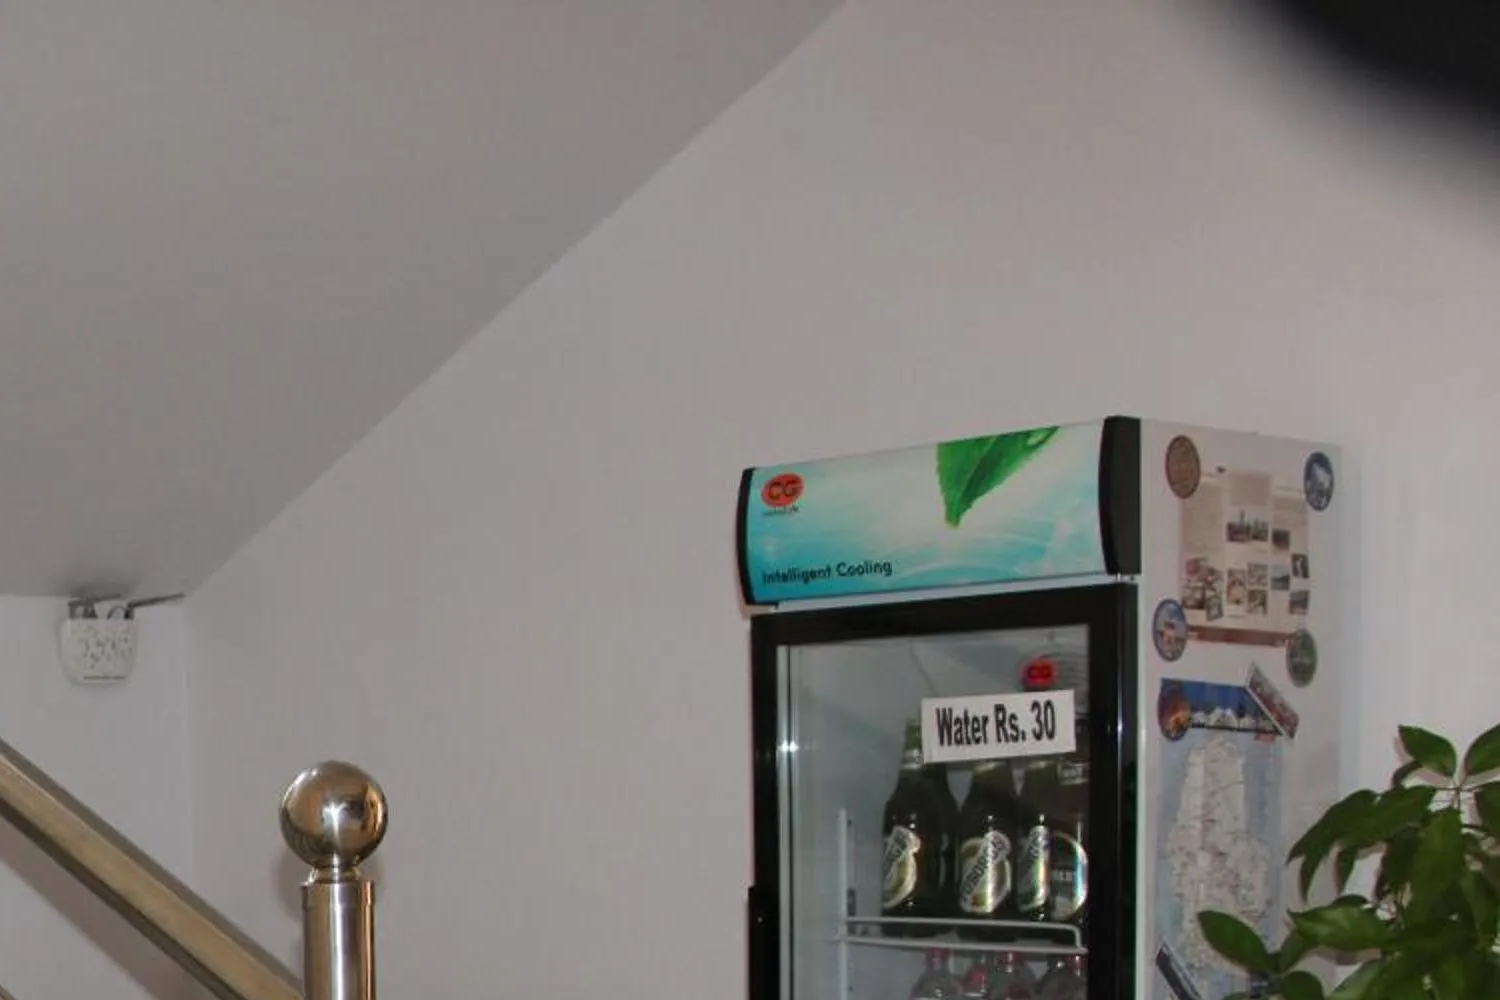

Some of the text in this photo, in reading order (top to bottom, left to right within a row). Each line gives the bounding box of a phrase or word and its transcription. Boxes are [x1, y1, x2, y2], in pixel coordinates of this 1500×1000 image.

[766, 478, 801, 501] CG
[764, 560, 893, 585] Intelligent Cooling
[936, 699, 1056, 747] Water Rs. 30
